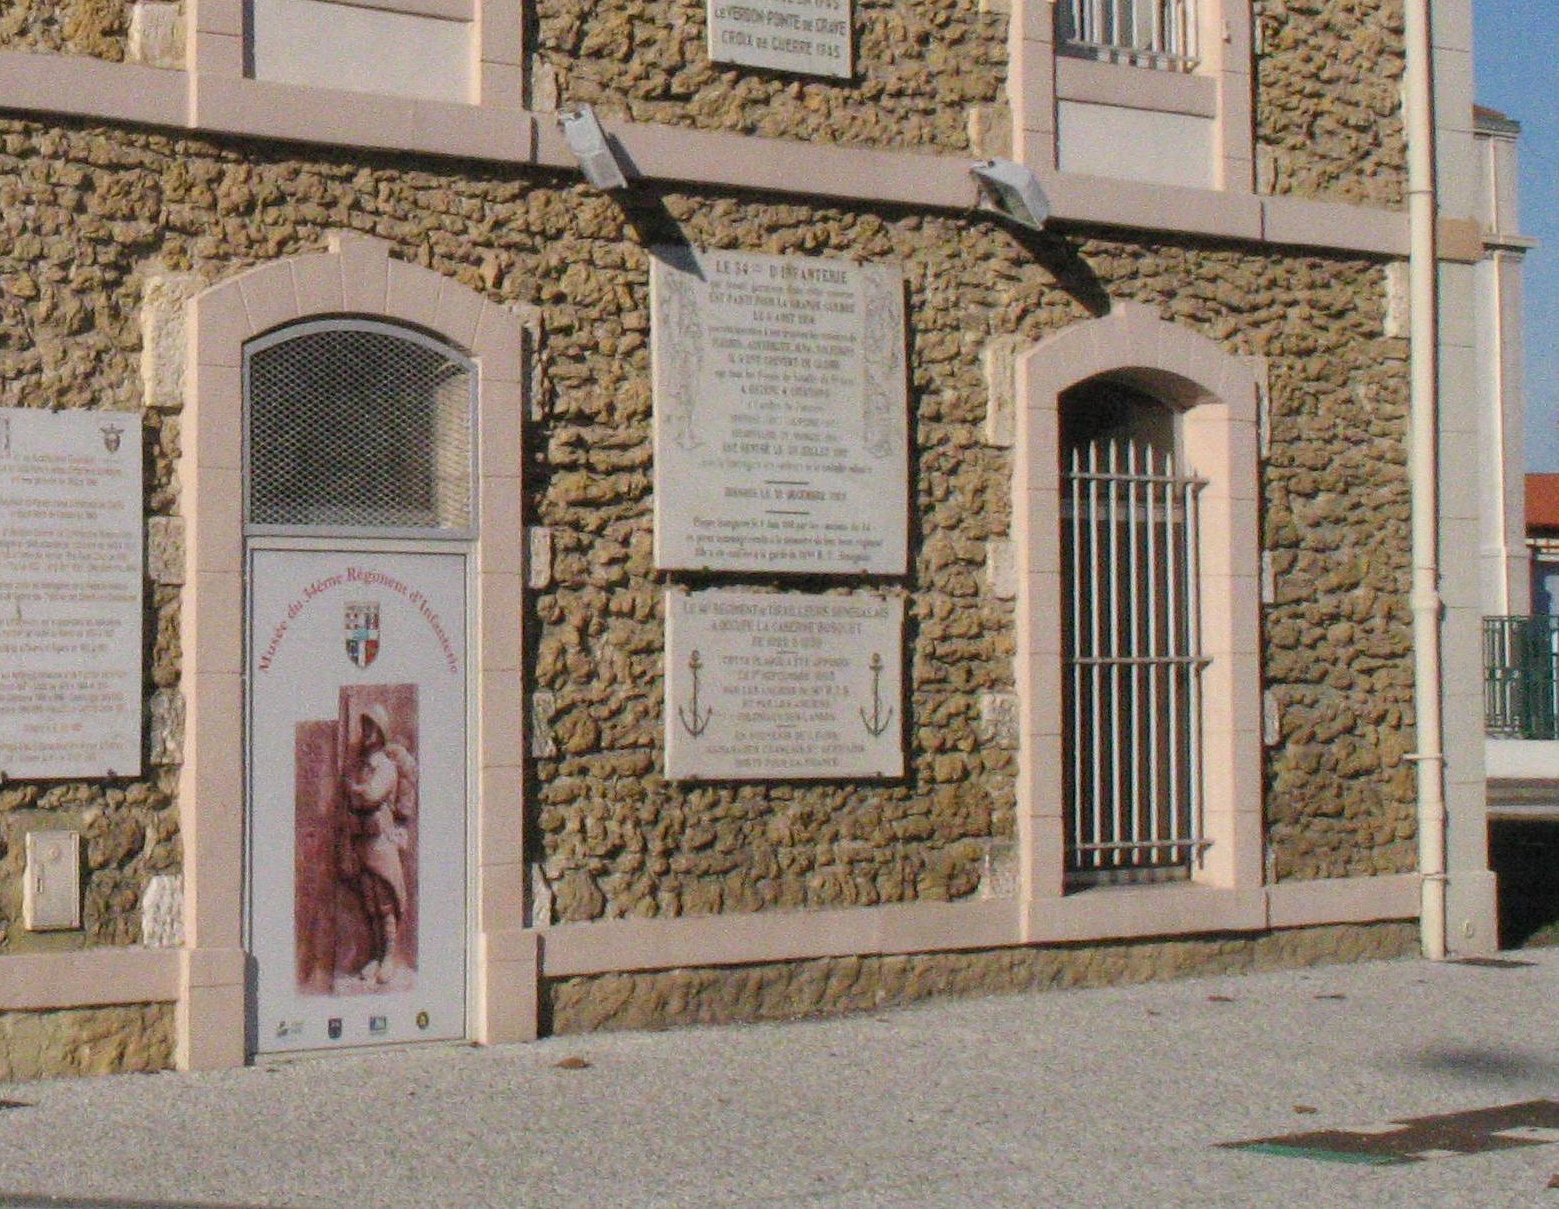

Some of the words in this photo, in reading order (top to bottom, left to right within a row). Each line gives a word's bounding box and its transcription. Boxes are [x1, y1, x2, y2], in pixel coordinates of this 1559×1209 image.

[721, 30, 753, 47] CROIX
[771, 37, 813, 56] GUERRE
[715, 260, 730, 275] LE
[258, 620, 287, 674] Musée
[288, 599, 304, 620] du
[345, 566, 408, 596] Régiment
[408, 590, 459, 676] d'Infanterie
